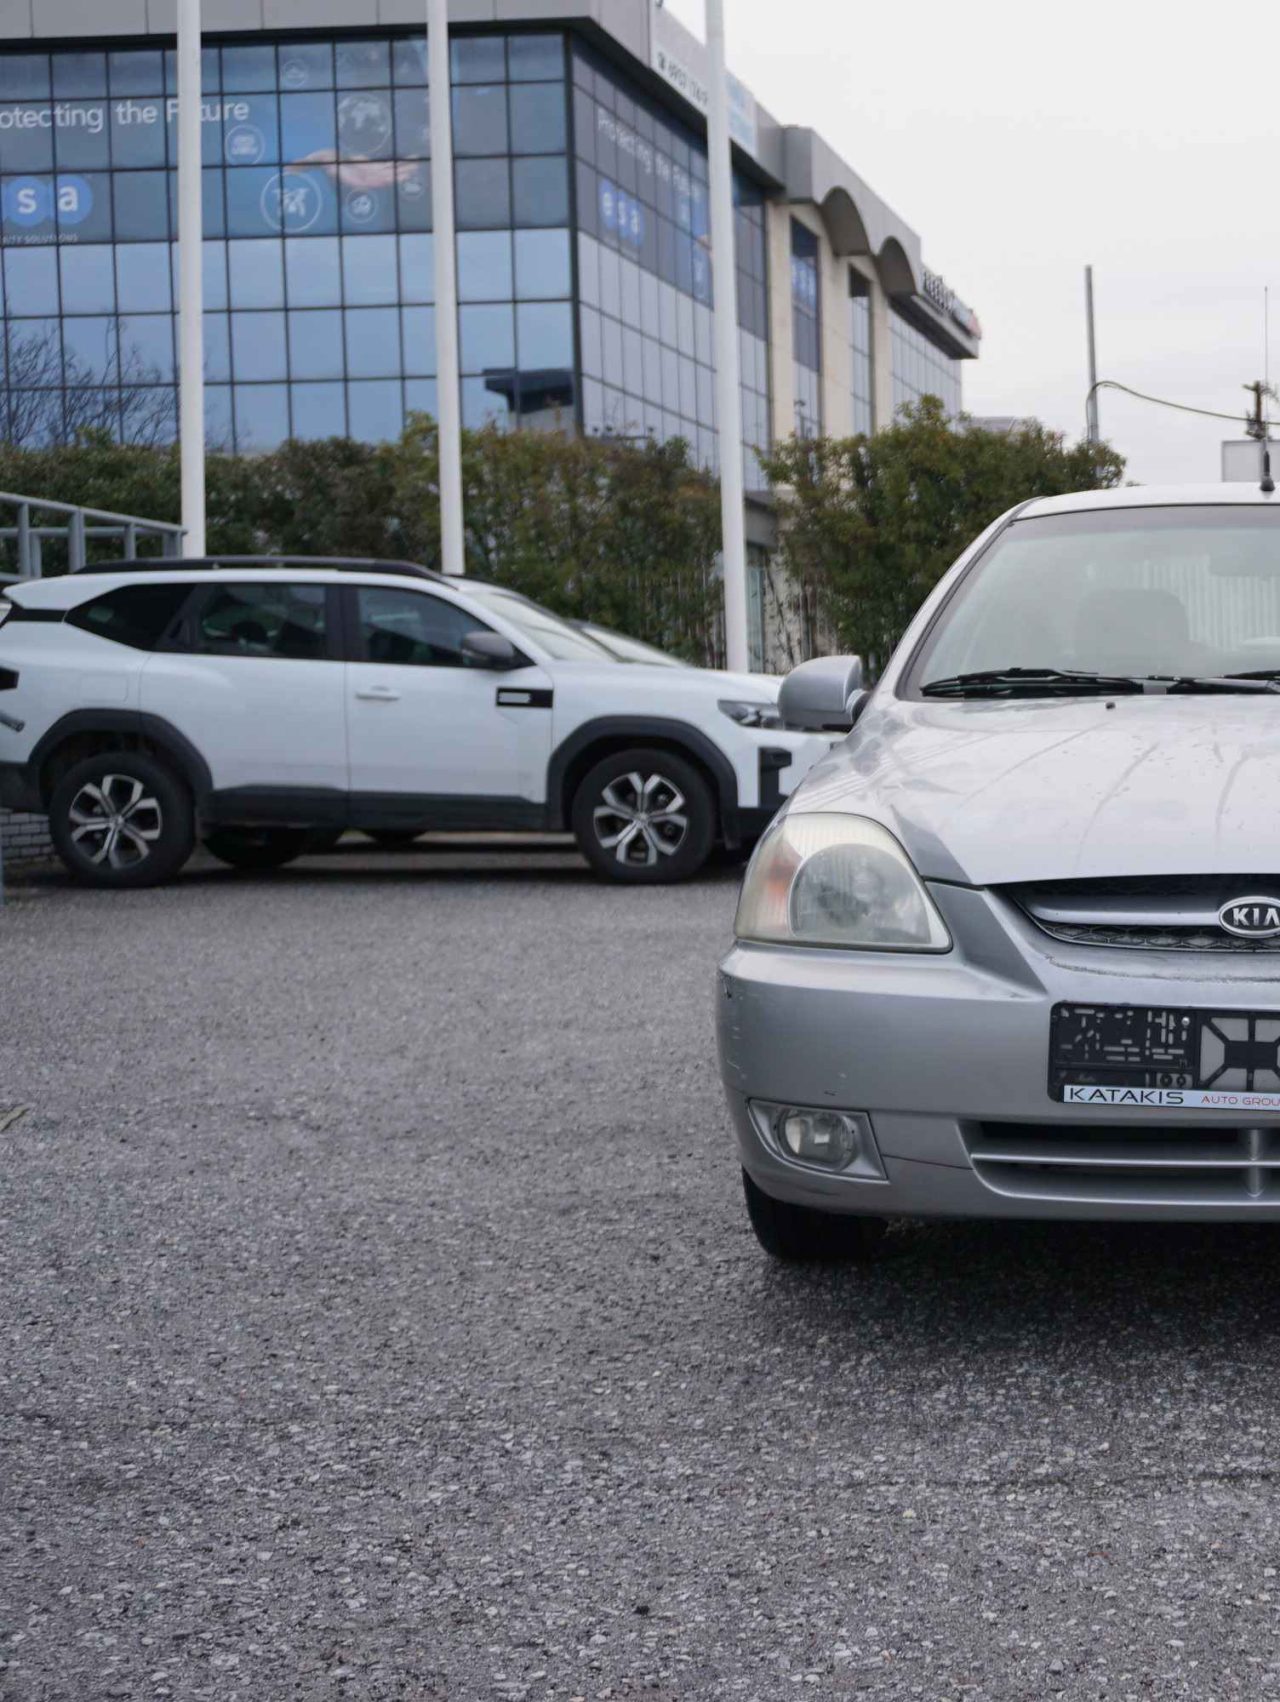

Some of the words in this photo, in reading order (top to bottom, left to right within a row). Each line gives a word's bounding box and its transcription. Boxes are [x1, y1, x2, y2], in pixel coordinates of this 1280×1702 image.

[116, 101, 157, 124] the
[1232, 907, 1280, 926] KIA
[1069, 1088, 1184, 1105] KATAKIS
[1201, 1096, 1239, 1105] AUTO
